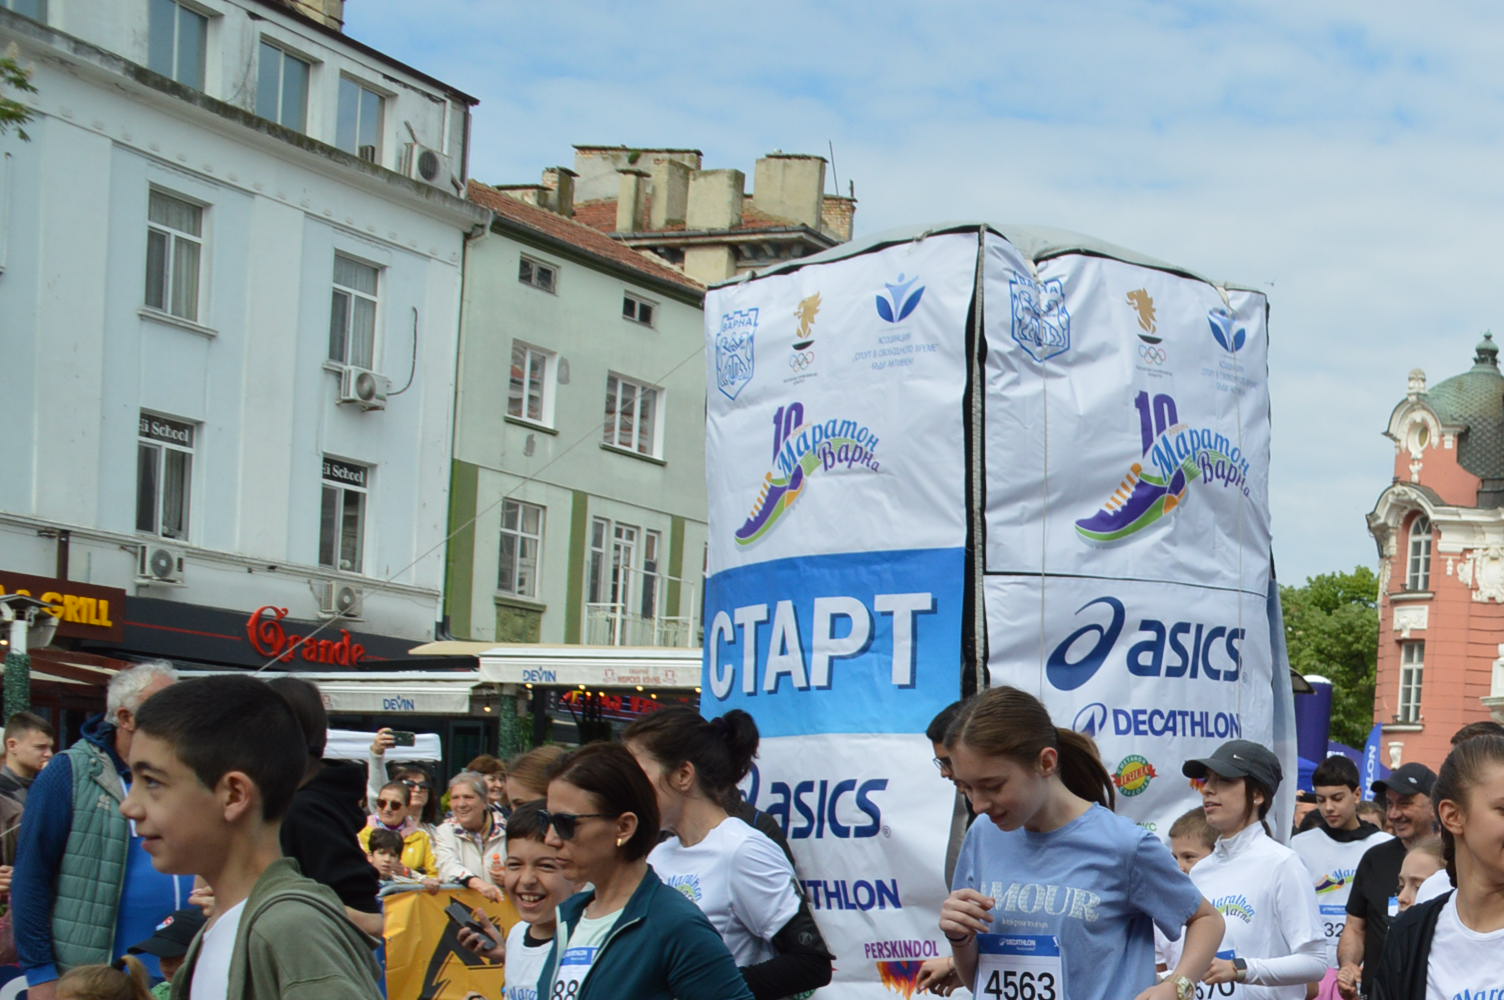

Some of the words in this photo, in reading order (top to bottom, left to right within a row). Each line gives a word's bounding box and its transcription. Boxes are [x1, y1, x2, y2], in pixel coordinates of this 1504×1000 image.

[773, 401, 805, 466] 10
[1134, 389, 1179, 460] 10
[778, 418, 880, 480] Маратон
[817, 440, 881, 473] Варна
[1151, 428, 1250, 483] Маратон
[1197, 450, 1250, 498] Варна
[41, 591, 113, 628] GRILL
[246, 605, 365, 666] Grande
[709, 592, 936, 699] СТАРТ
[522, 668, 557, 683] DEVIN
[383, 695, 415, 711] DEVIN
[1112, 708, 1242, 738] DECATHLON
[864, 940, 940, 959] PERSKINDOL
